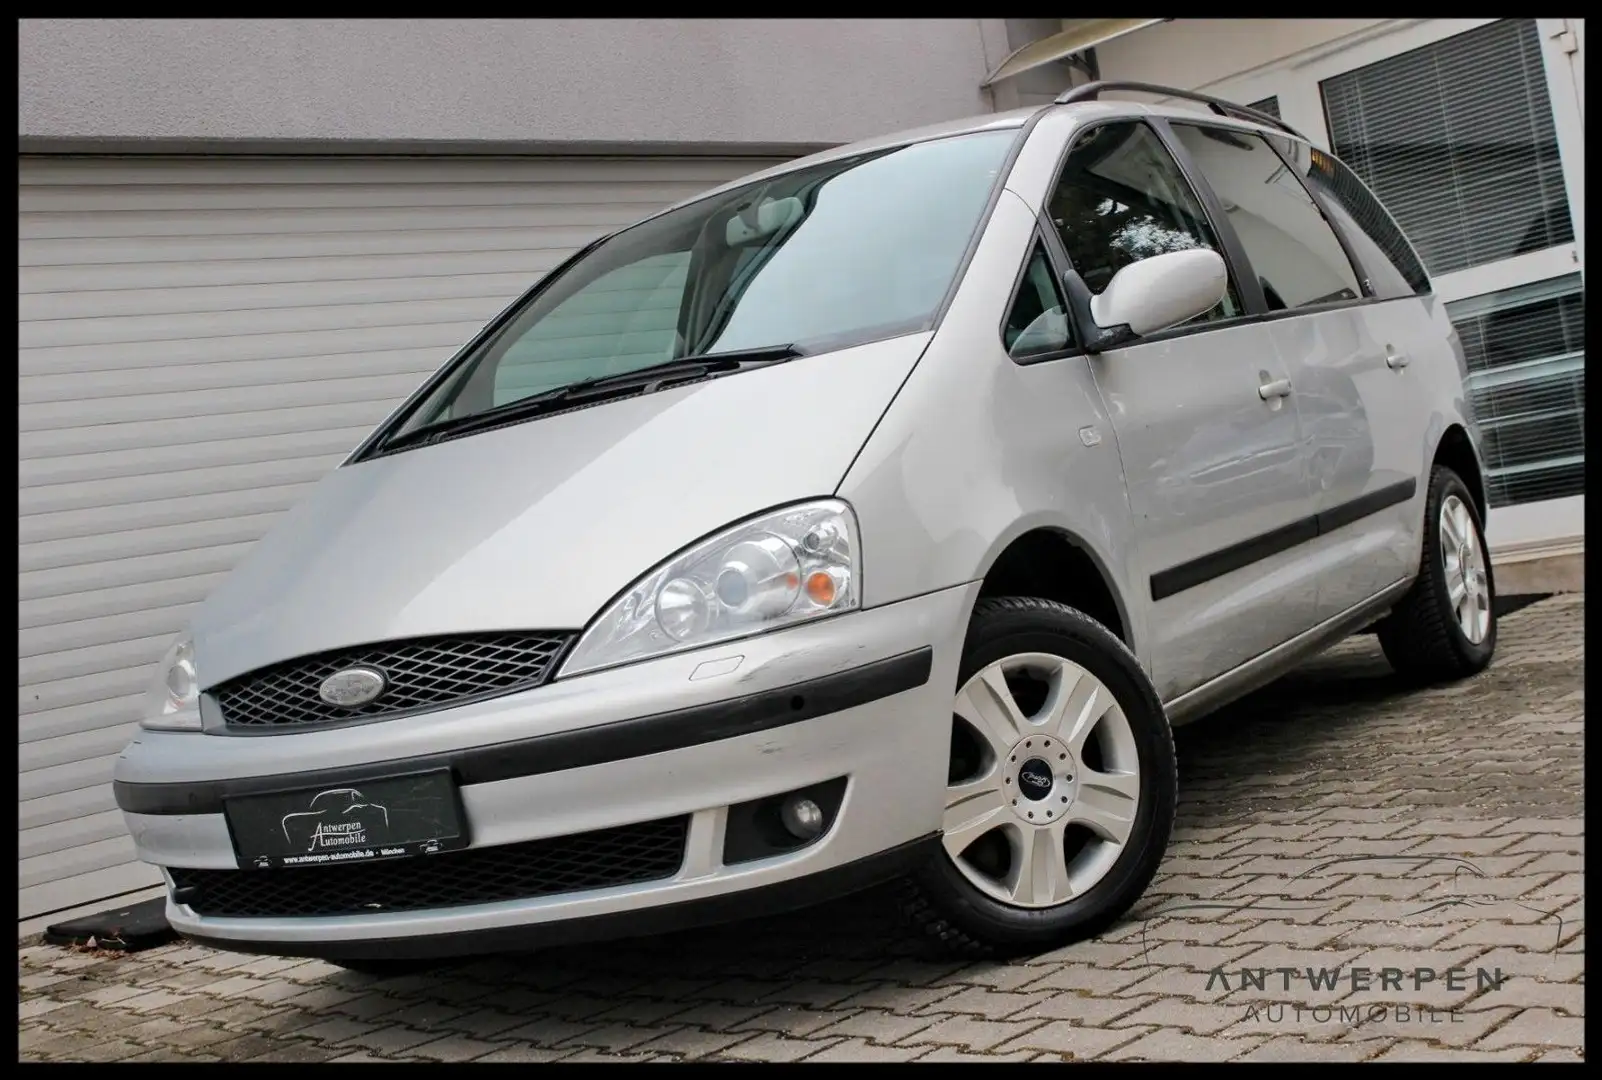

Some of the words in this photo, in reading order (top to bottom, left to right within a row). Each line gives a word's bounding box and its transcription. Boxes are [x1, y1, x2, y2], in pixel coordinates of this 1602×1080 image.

[309, 822, 363, 838] Antwerpen
[309, 832, 366, 848] Automobile
[284, 850, 374, 864] www.antwerpen-automobile.de
